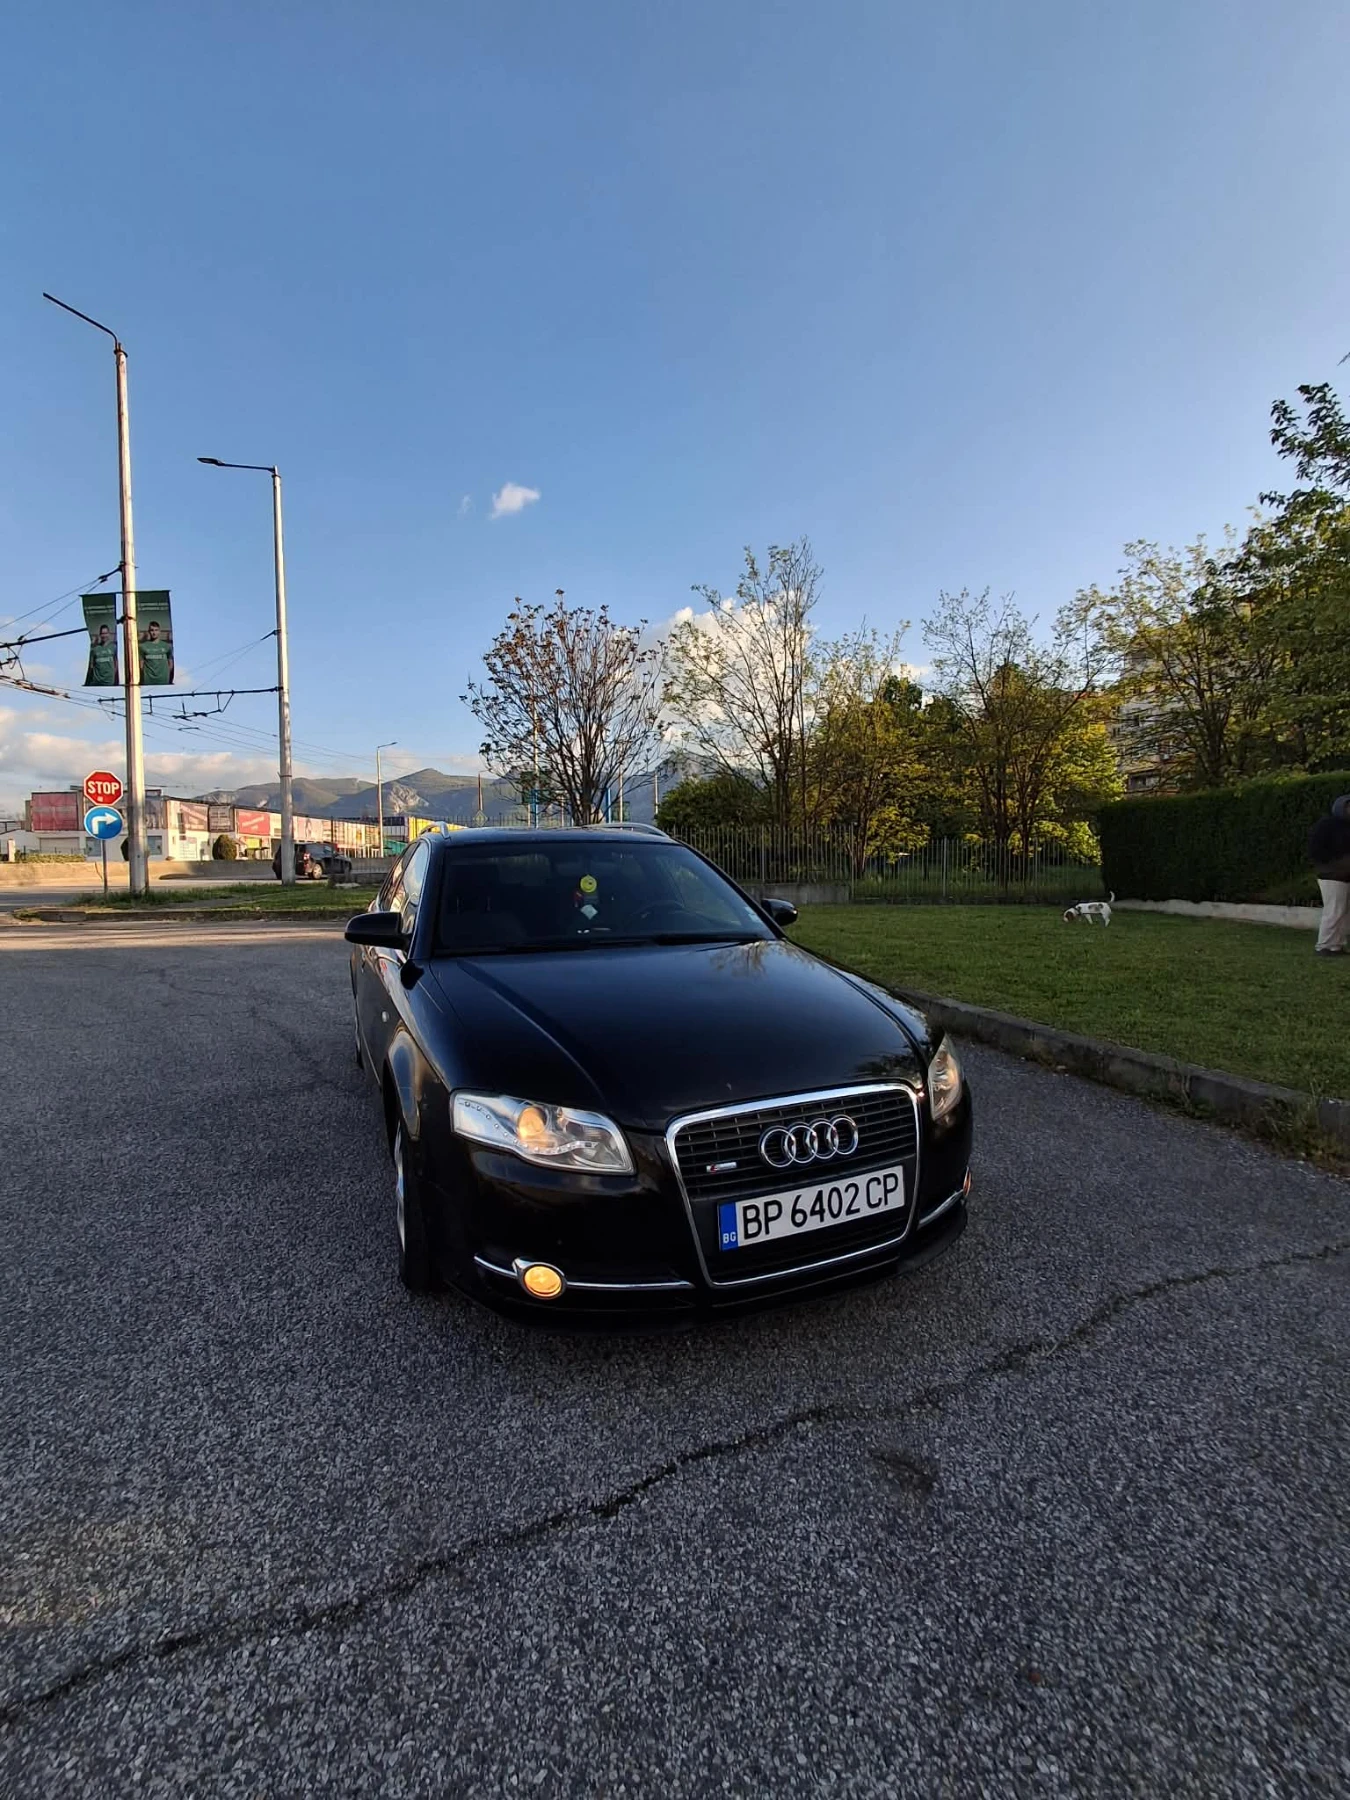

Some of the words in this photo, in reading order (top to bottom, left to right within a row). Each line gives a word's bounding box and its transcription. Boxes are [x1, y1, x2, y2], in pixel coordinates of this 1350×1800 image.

[87, 781, 120, 795] STOP
[742, 1200, 782, 1240] BP
[790, 1182, 861, 1228] 6402
[866, 1173, 899, 1209] CP
[722, 1231, 737, 1244] BG
